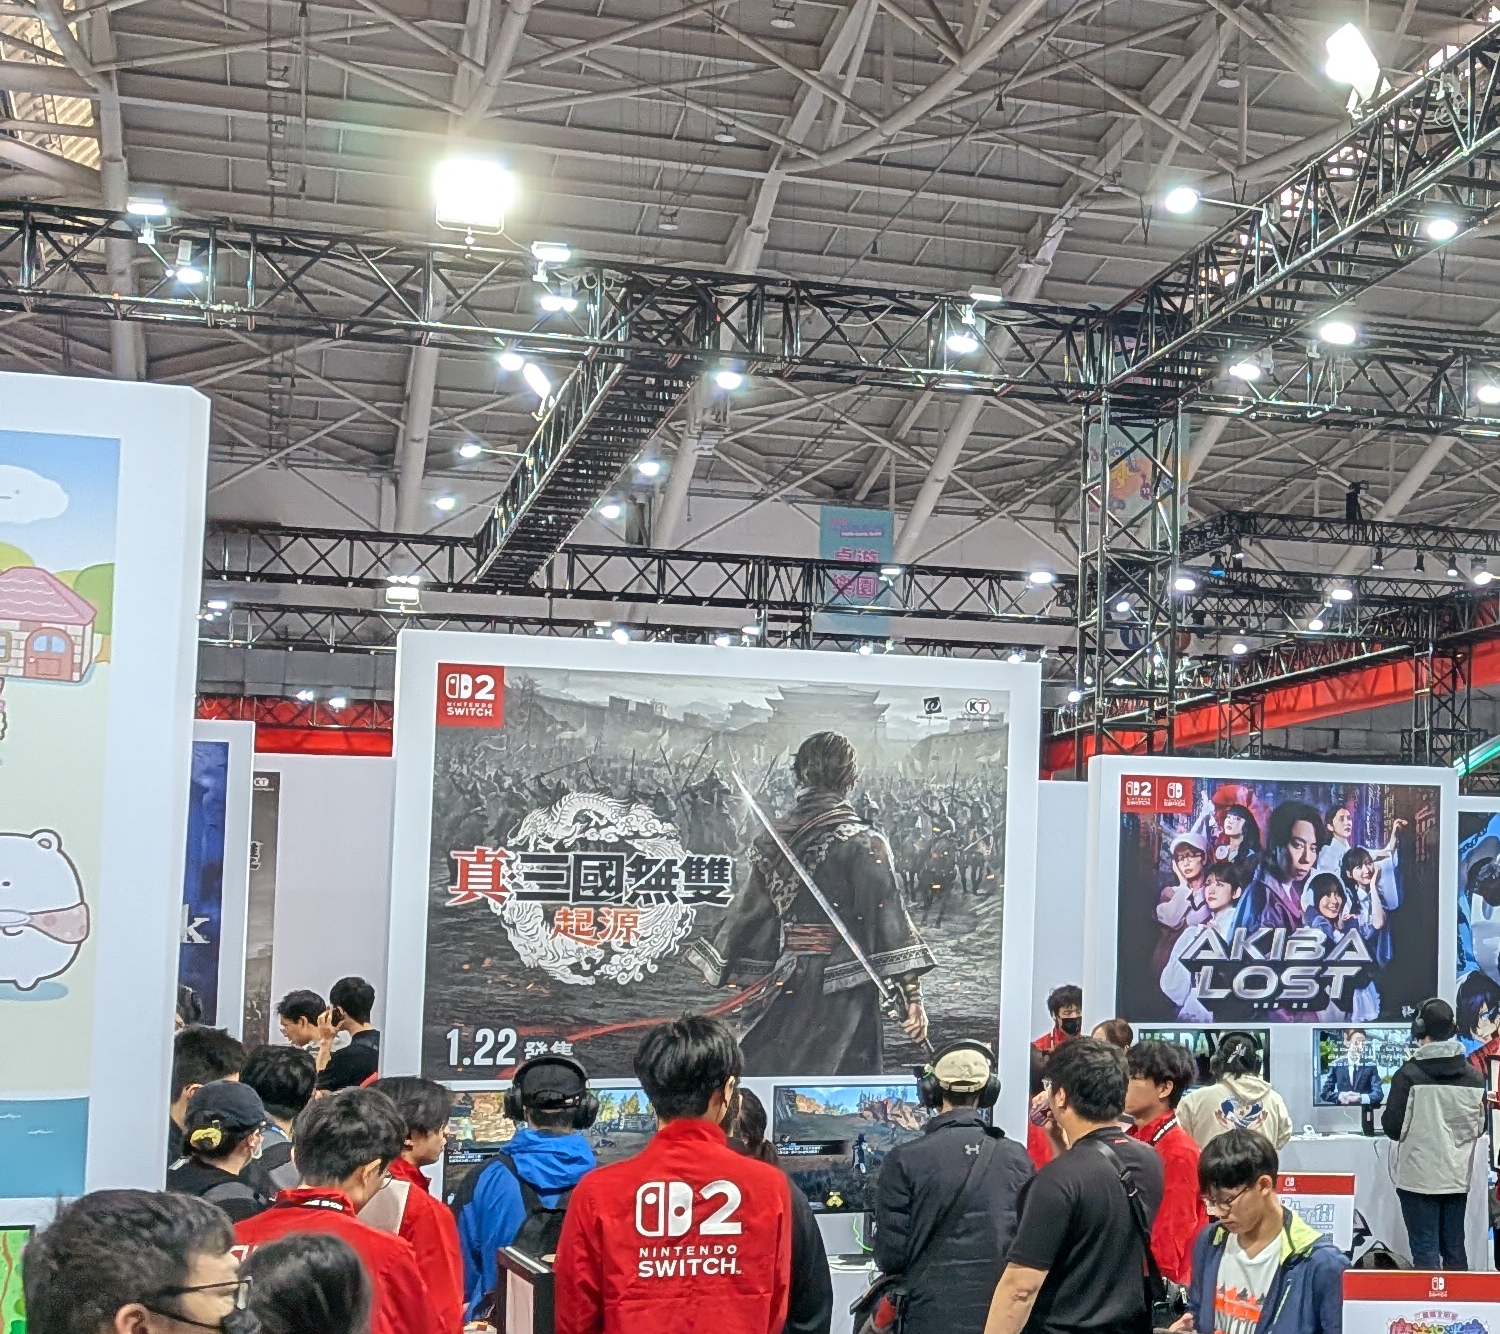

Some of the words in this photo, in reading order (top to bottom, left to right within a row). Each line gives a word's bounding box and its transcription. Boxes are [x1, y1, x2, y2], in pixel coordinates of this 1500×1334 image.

[474, 674, 495, 701] 2
[446, 707, 493, 717] SWITCH
[550, 906, 642, 947] 起源
[1180, 927, 1374, 962] AKIBA
[1197, 965, 1363, 1000] LOST
[446, 1028, 518, 1066] 1.22
[699, 1179, 742, 1236] 2
[638, 1244, 738, 1258] NINTENDO
[638, 1257, 738, 1279] SWITCH
